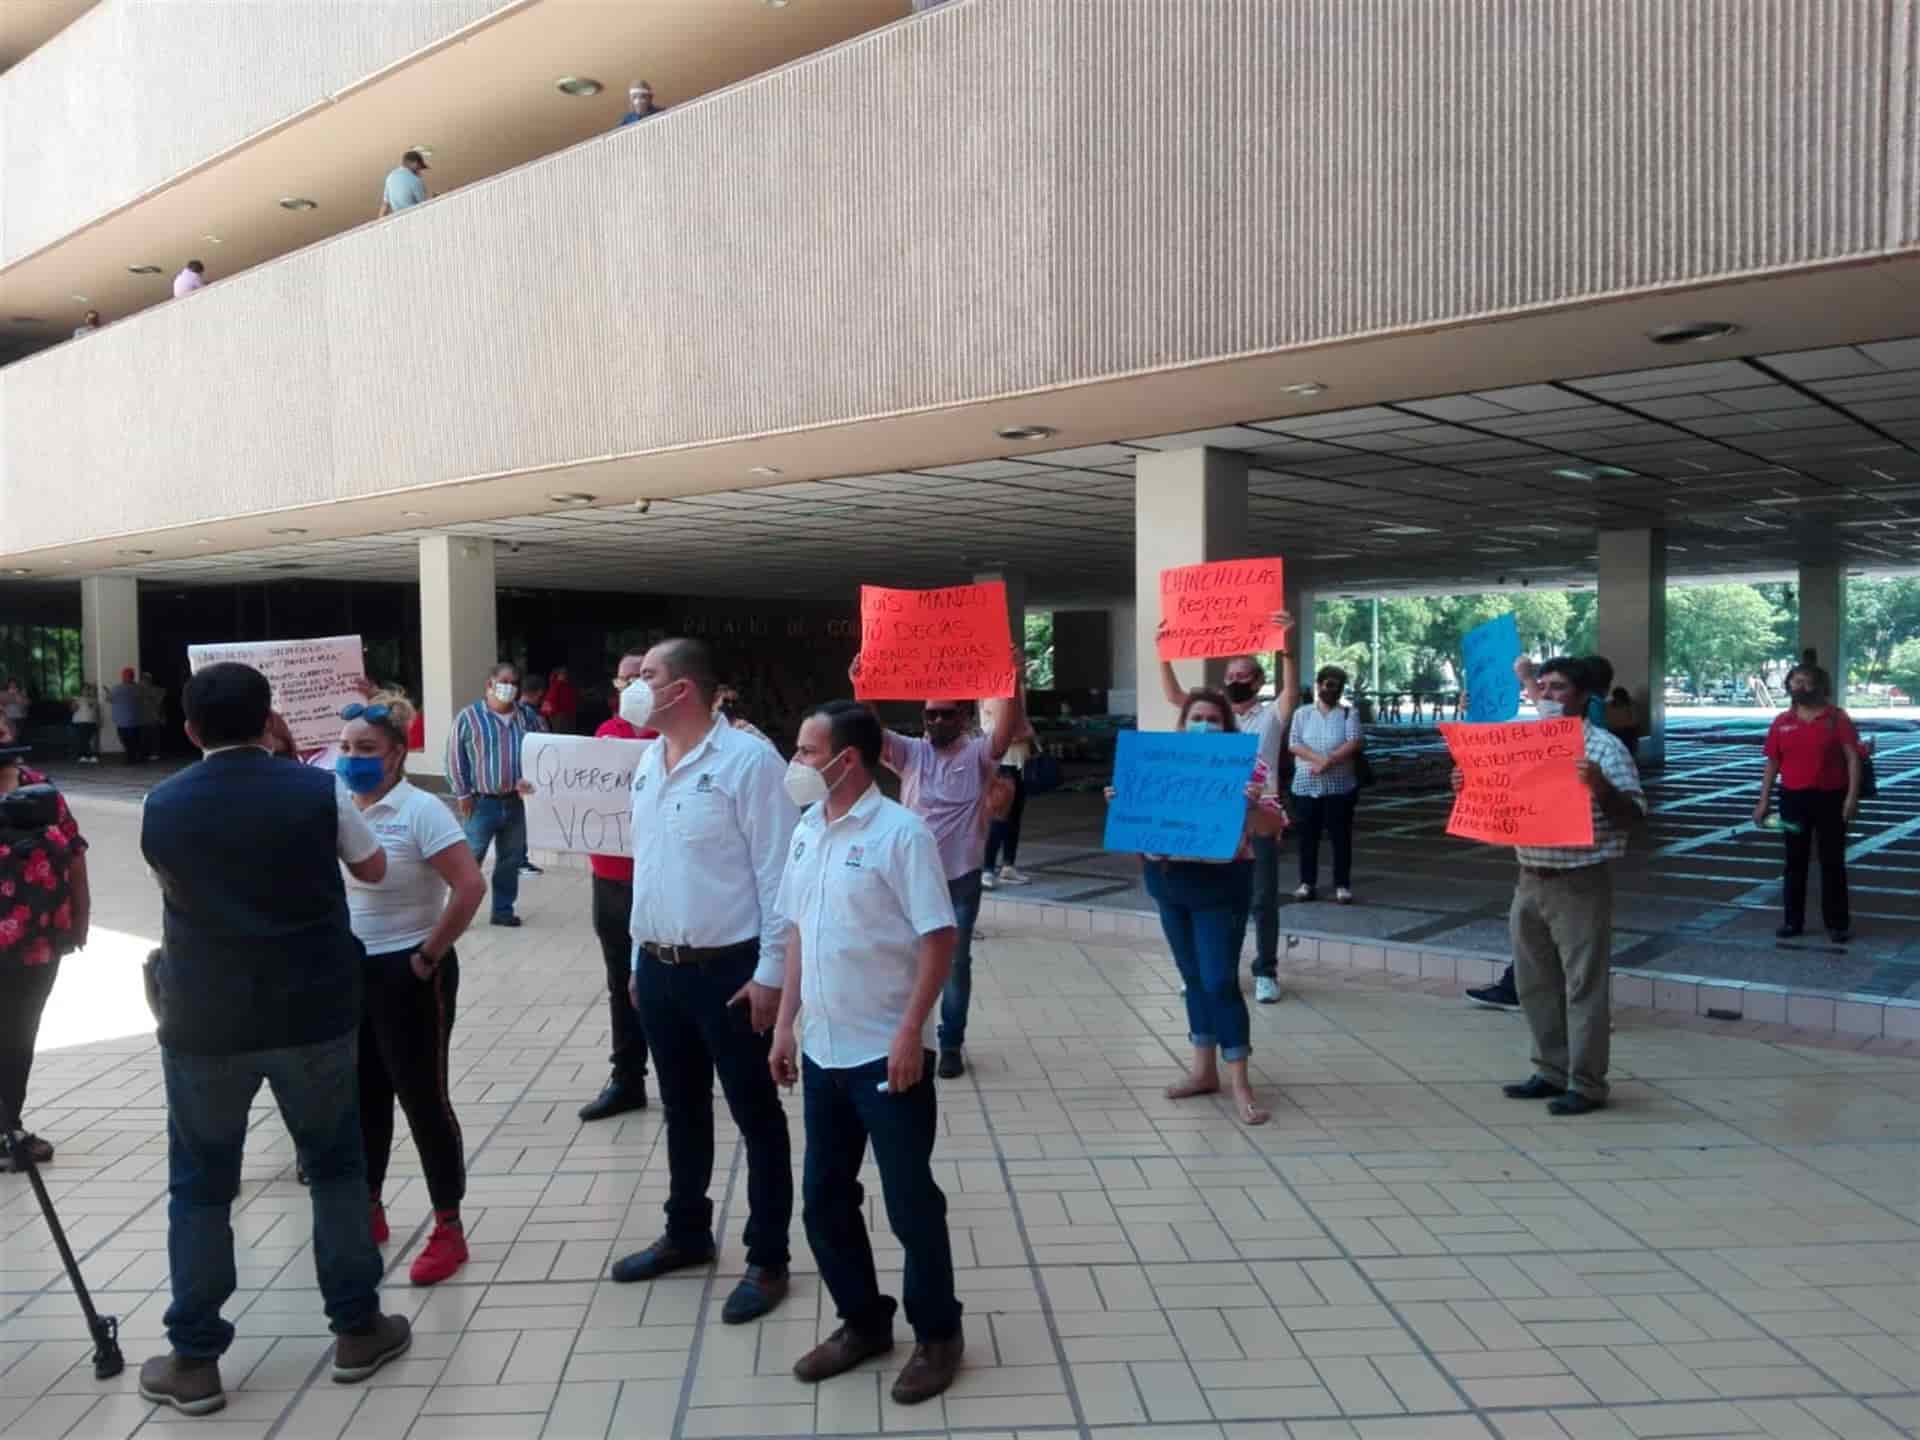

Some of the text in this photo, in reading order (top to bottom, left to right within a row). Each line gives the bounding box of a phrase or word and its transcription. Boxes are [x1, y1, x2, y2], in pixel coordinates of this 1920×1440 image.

[1162, 568, 1279, 594] CHINCHILLAS
[1178, 595, 1248, 614] RESPETA
[1179, 634, 1267, 657] ICATSIN
[551, 800, 632, 852] VOT
